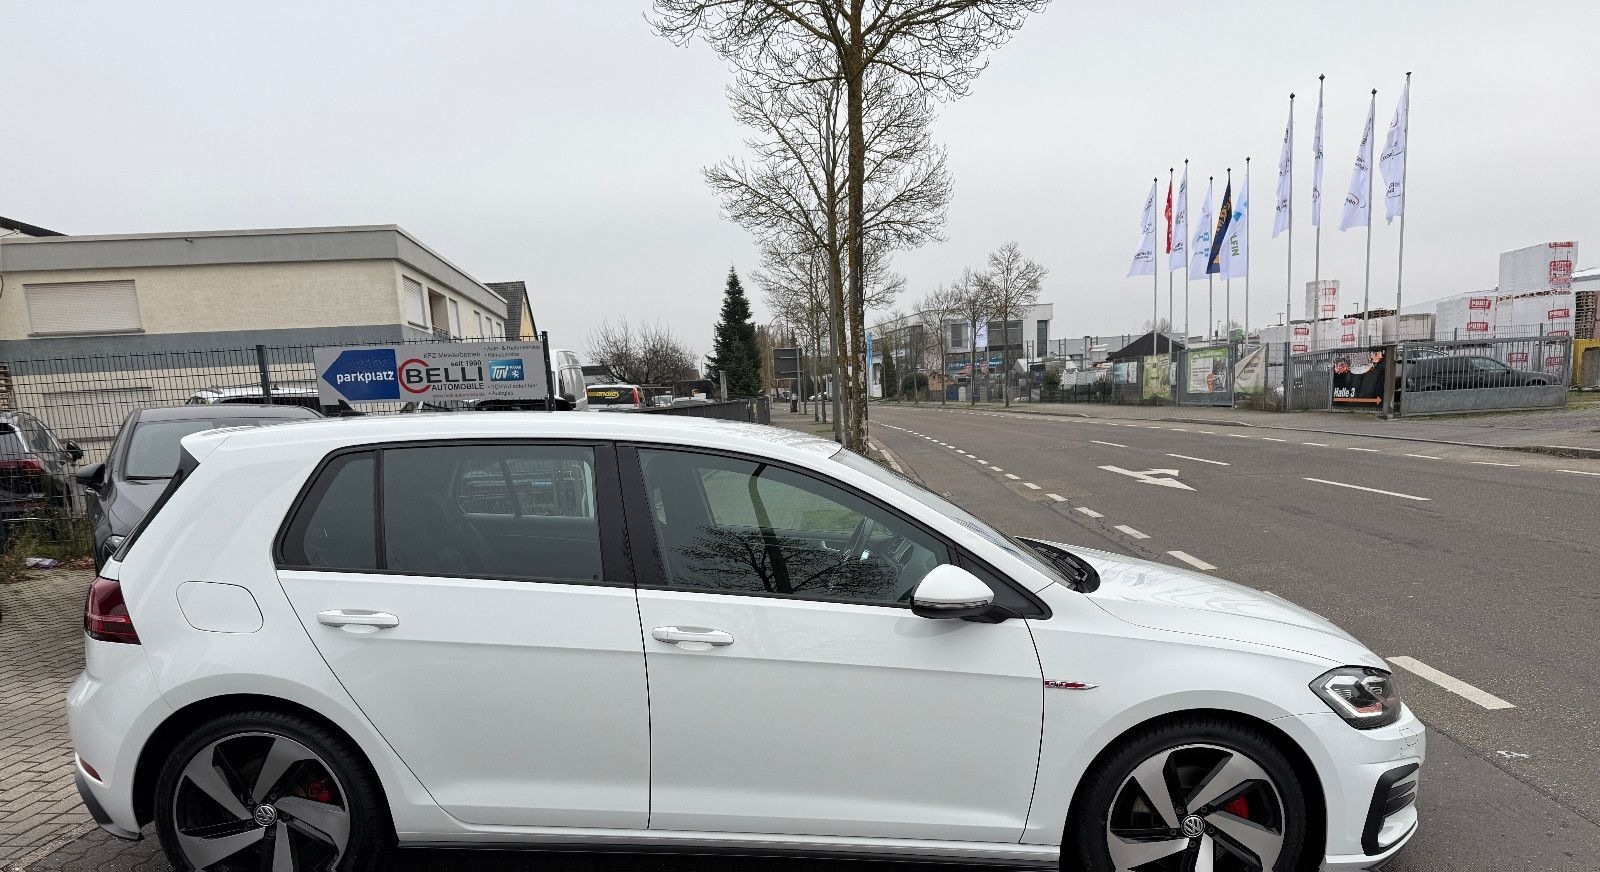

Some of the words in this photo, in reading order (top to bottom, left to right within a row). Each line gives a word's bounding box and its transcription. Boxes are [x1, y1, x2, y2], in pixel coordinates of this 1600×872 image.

[336, 371, 394, 385] parkplatz
[405, 366, 484, 384] BELLI
[431, 382, 484, 391] AUTOMOBILE
[1333, 388, 1350, 398] Halle
[1350, 387, 1356, 398] 3
